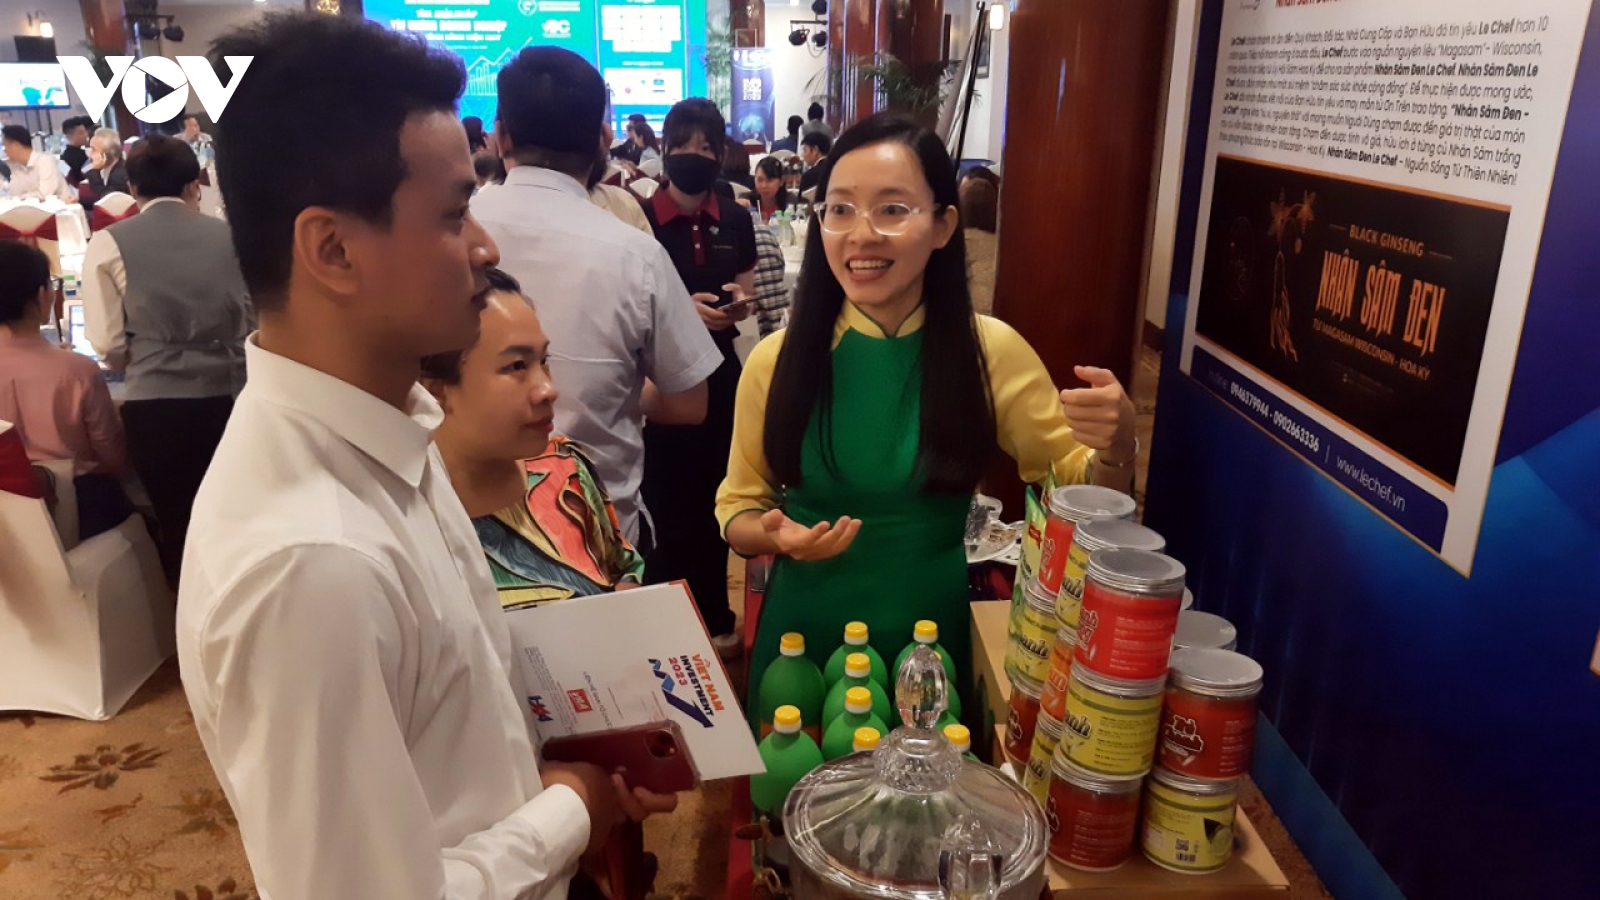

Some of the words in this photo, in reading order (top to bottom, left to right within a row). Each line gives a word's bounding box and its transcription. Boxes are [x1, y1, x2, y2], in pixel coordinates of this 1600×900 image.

[1360, 28, 1377, 43] Cung
[1379, 25, 1392, 41] Cấp
[1404, 25, 1418, 41] Bạn
[1461, 21, 1477, 39] yêu
[1479, 20, 1489, 35] Le
[1491, 17, 1515, 34] Chef
[1516, 18, 1536, 33] hơn
[1539, 15, 1549, 31] 10
[1395, 45, 1421, 60] nguyên
[1374, 63, 1393, 76] Nhân
[1394, 62, 1410, 76] Sâm
[1411, 64, 1425, 76] Đen
[1426, 64, 1436, 76] Le
[1459, 62, 1481, 76] Nhân
[1483, 62, 1505, 77] Sâm
[1506, 63, 1526, 77] Đen
[1526, 63, 1539, 77] Le
[1441, 83, 1458, 99] hiện
[1460, 83, 1481, 100] được
[1484, 87, 1511, 103] mong
[1480, 104, 1500, 119] Sâm
[1502, 105, 1522, 120] Đen
[1403, 119, 1422, 135] được
[1439, 122, 1452, 139] giá
[1464, 124, 1482, 141] thật
[1483, 125, 1501, 141] của
[1344, 148, 1358, 161] Sâm
[1359, 150, 1371, 162] Đen
[1372, 152, 1380, 165] Le
[1381, 153, 1398, 167] Chef
[1404, 156, 1429, 174] Nguồn
[1430, 159, 1451, 180] Sống
[1453, 162, 1463, 177] Từ
[1464, 164, 1486, 181] Thiên
[1449, 143, 1471, 159] Nhân
[1473, 144, 1493, 161] Sâm
[1496, 147, 1521, 169] trồng
[1349, 224, 1378, 245] BLACK
[1380, 232, 1425, 257] GINSENG
[1315, 248, 1360, 322] NHÂN
[1360, 259, 1402, 338] SÂM
[1403, 278, 1447, 358] ĐEN
[1354, 337, 1396, 366] WISCONSIN
[1399, 357, 1418, 376] HOA
[1230, 382, 1270, 418] 0946379944
[1273, 410, 1320, 452] 0902663336
[1336, 455, 1406, 512] www.lechef.vn
[668, 656, 689, 687] 2023
[679, 655, 715, 717] INVESTMENT
[705, 683, 725, 711] NAM
